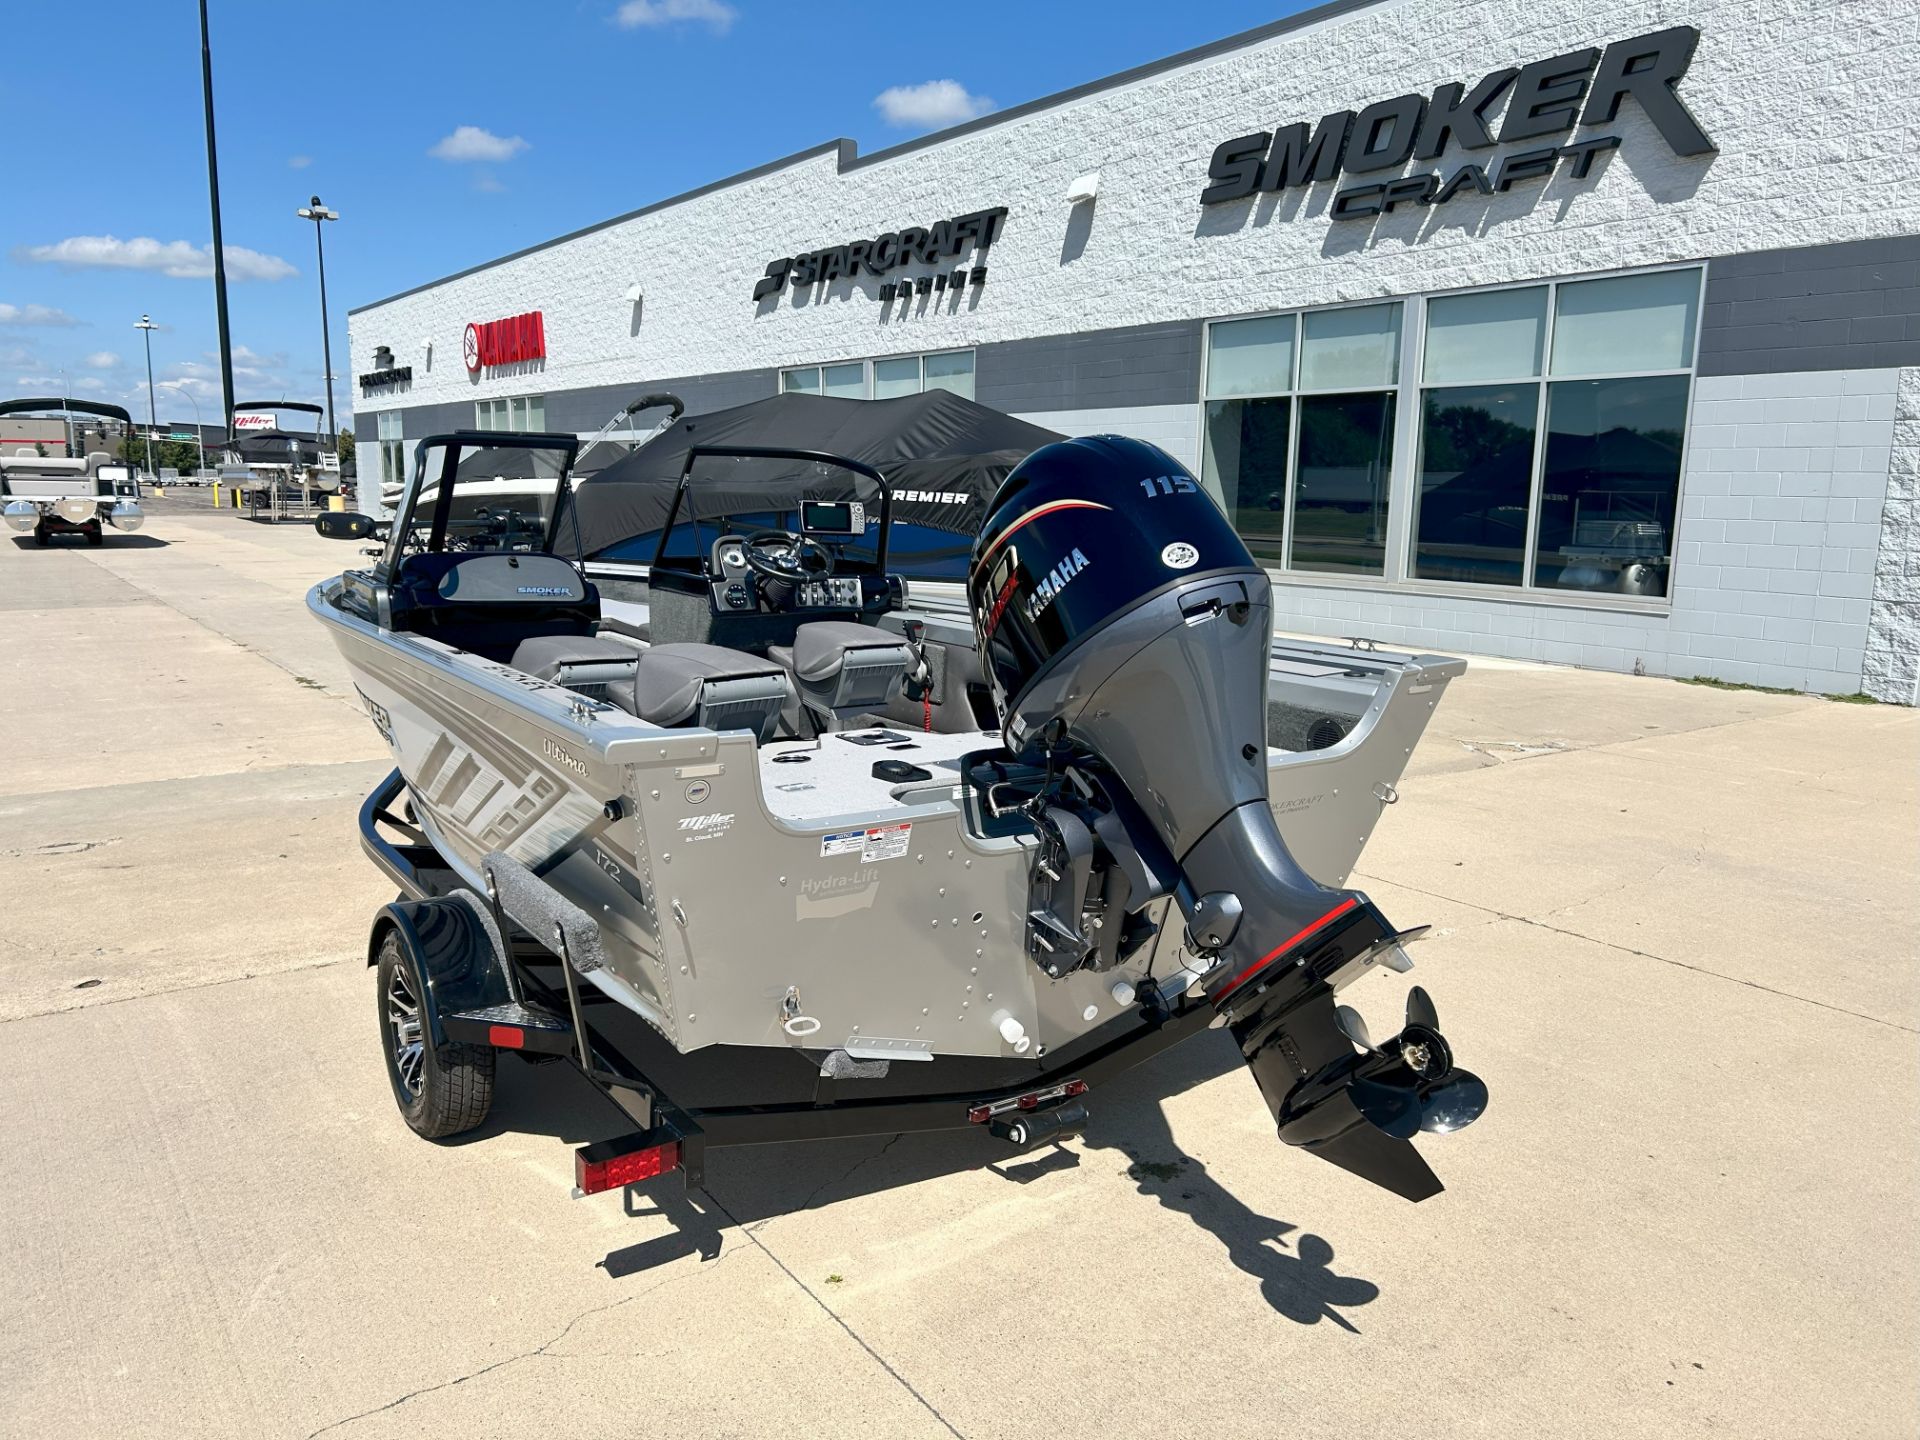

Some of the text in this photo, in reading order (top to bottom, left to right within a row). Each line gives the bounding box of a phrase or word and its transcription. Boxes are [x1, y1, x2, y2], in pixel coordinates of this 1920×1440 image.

[1201, 26, 1719, 204] SMOKER
[1330, 136, 1622, 221] CRAFT
[791, 207, 1008, 287] STARCRAFT
[879, 266, 987, 302] MARINE
[1140, 475, 1197, 498] 115
[517, 587, 574, 597] SMOKER
[1024, 547, 1091, 624] YAMAHA
[543, 737, 590, 777] Ultima
[677, 812, 735, 830] Miller
[596, 849, 621, 882] 172
[800, 867, 879, 895] Hydra-Lift
